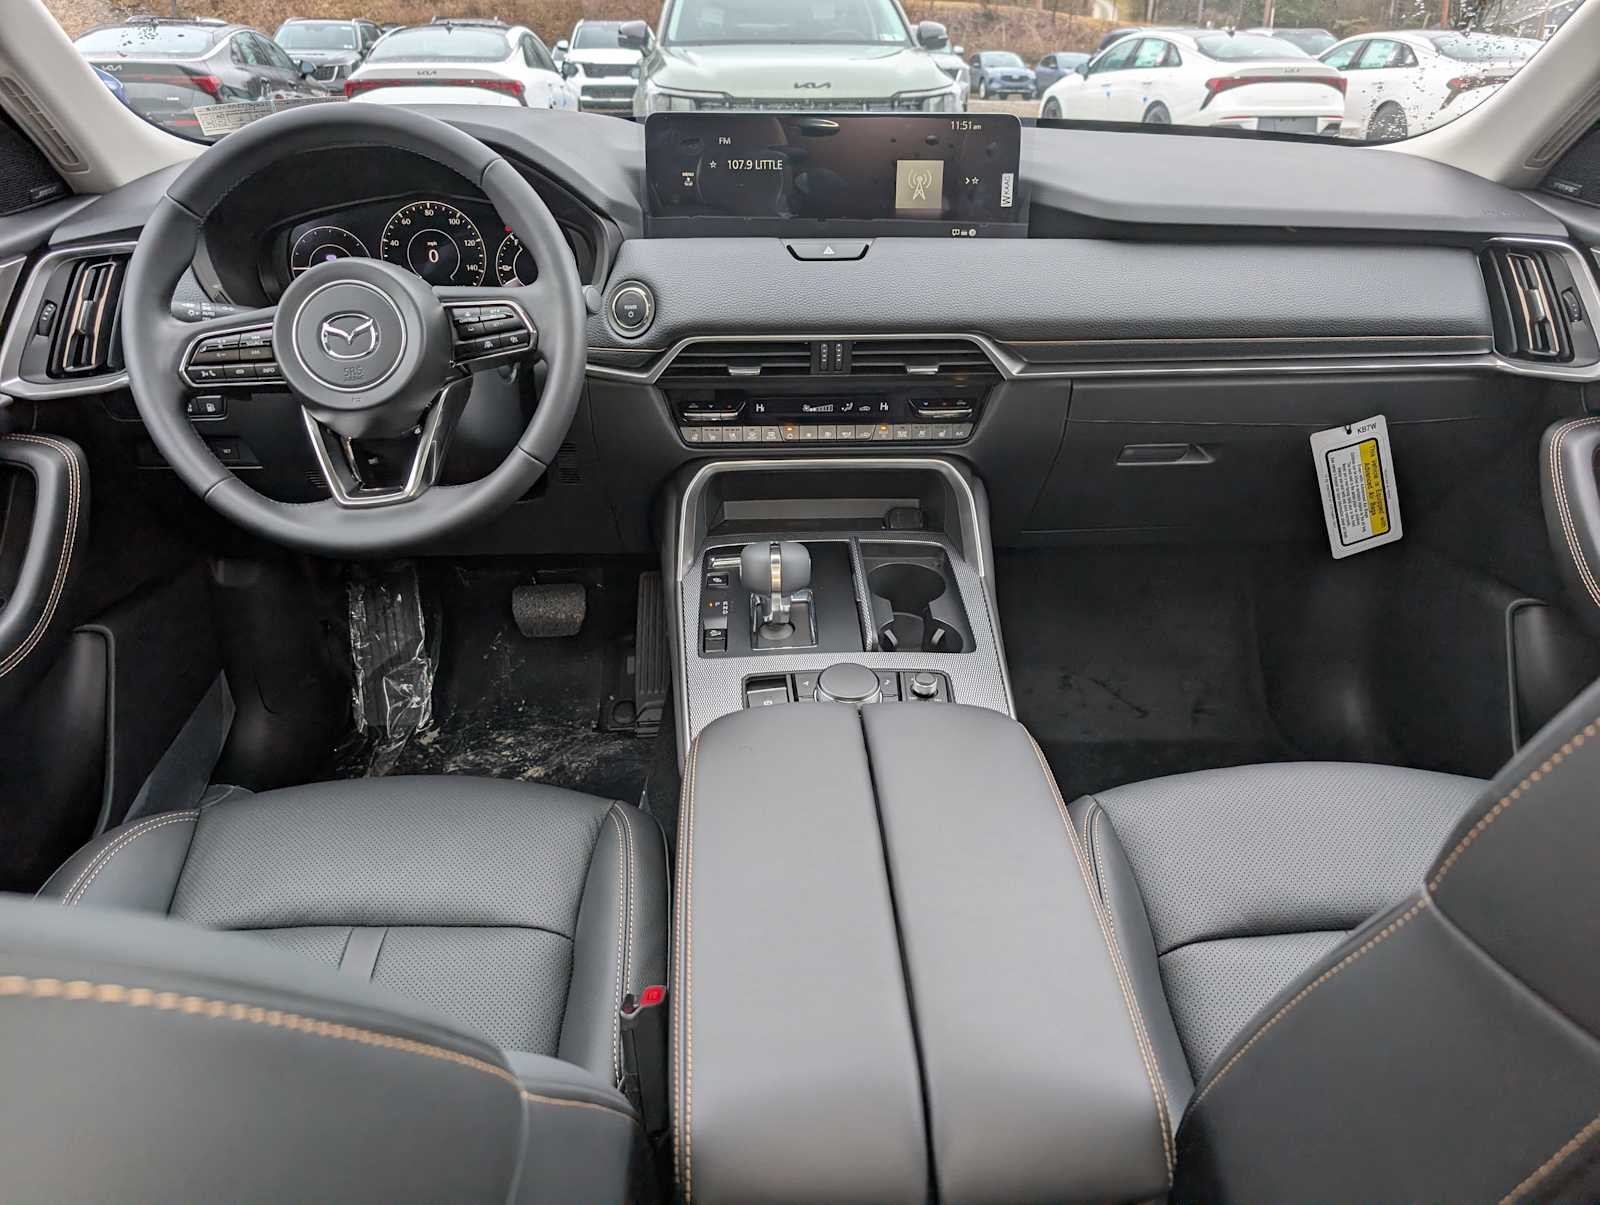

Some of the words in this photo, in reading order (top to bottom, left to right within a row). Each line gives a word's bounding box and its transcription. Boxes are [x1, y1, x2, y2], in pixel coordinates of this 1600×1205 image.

[794, 81, 831, 89] KIA
[719, 137, 731, 145] FM
[727, 160, 753, 170] 107.9
[755, 160, 783, 170] LITTLE
[428, 249, 439, 263] 0
